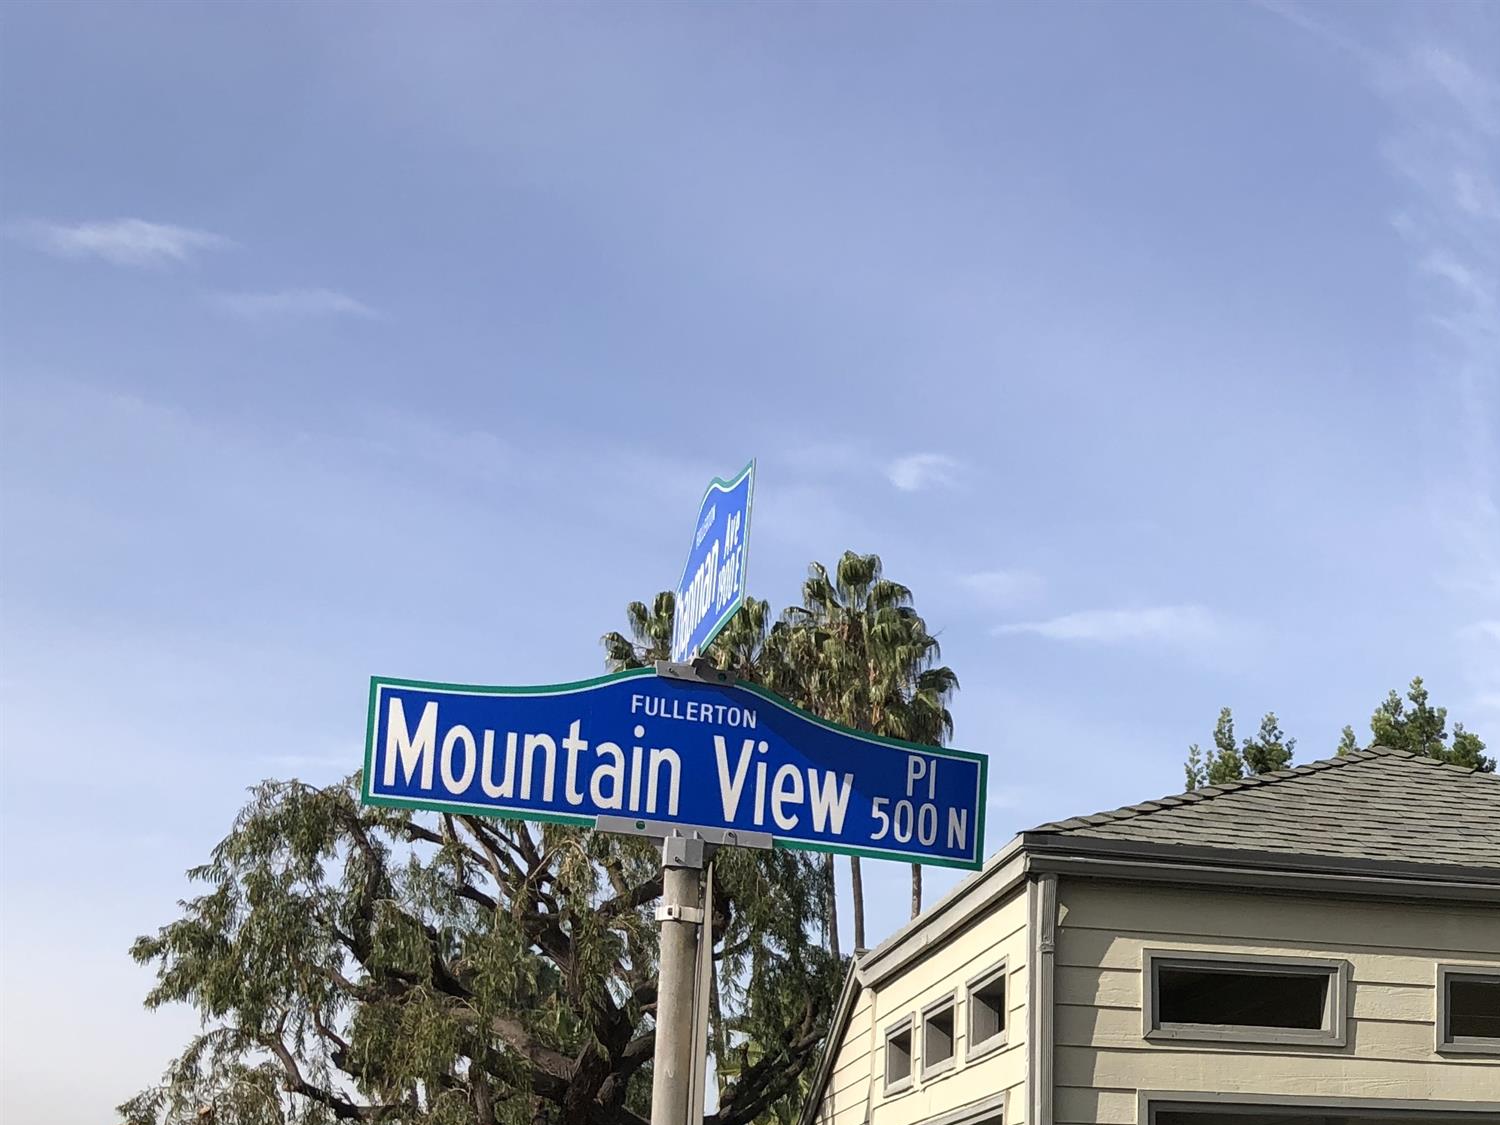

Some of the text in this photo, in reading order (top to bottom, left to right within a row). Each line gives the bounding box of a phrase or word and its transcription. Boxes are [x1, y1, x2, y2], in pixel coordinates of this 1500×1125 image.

[723, 508, 741, 561] Ave
[733, 543, 742, 594] E
[672, 538, 719, 662] Chapman
[630, 694, 757, 729] FULLERTON
[382, 697, 855, 834] Mountain View
[907, 755, 938, 801] Pl
[869, 799, 968, 851] 500 N
